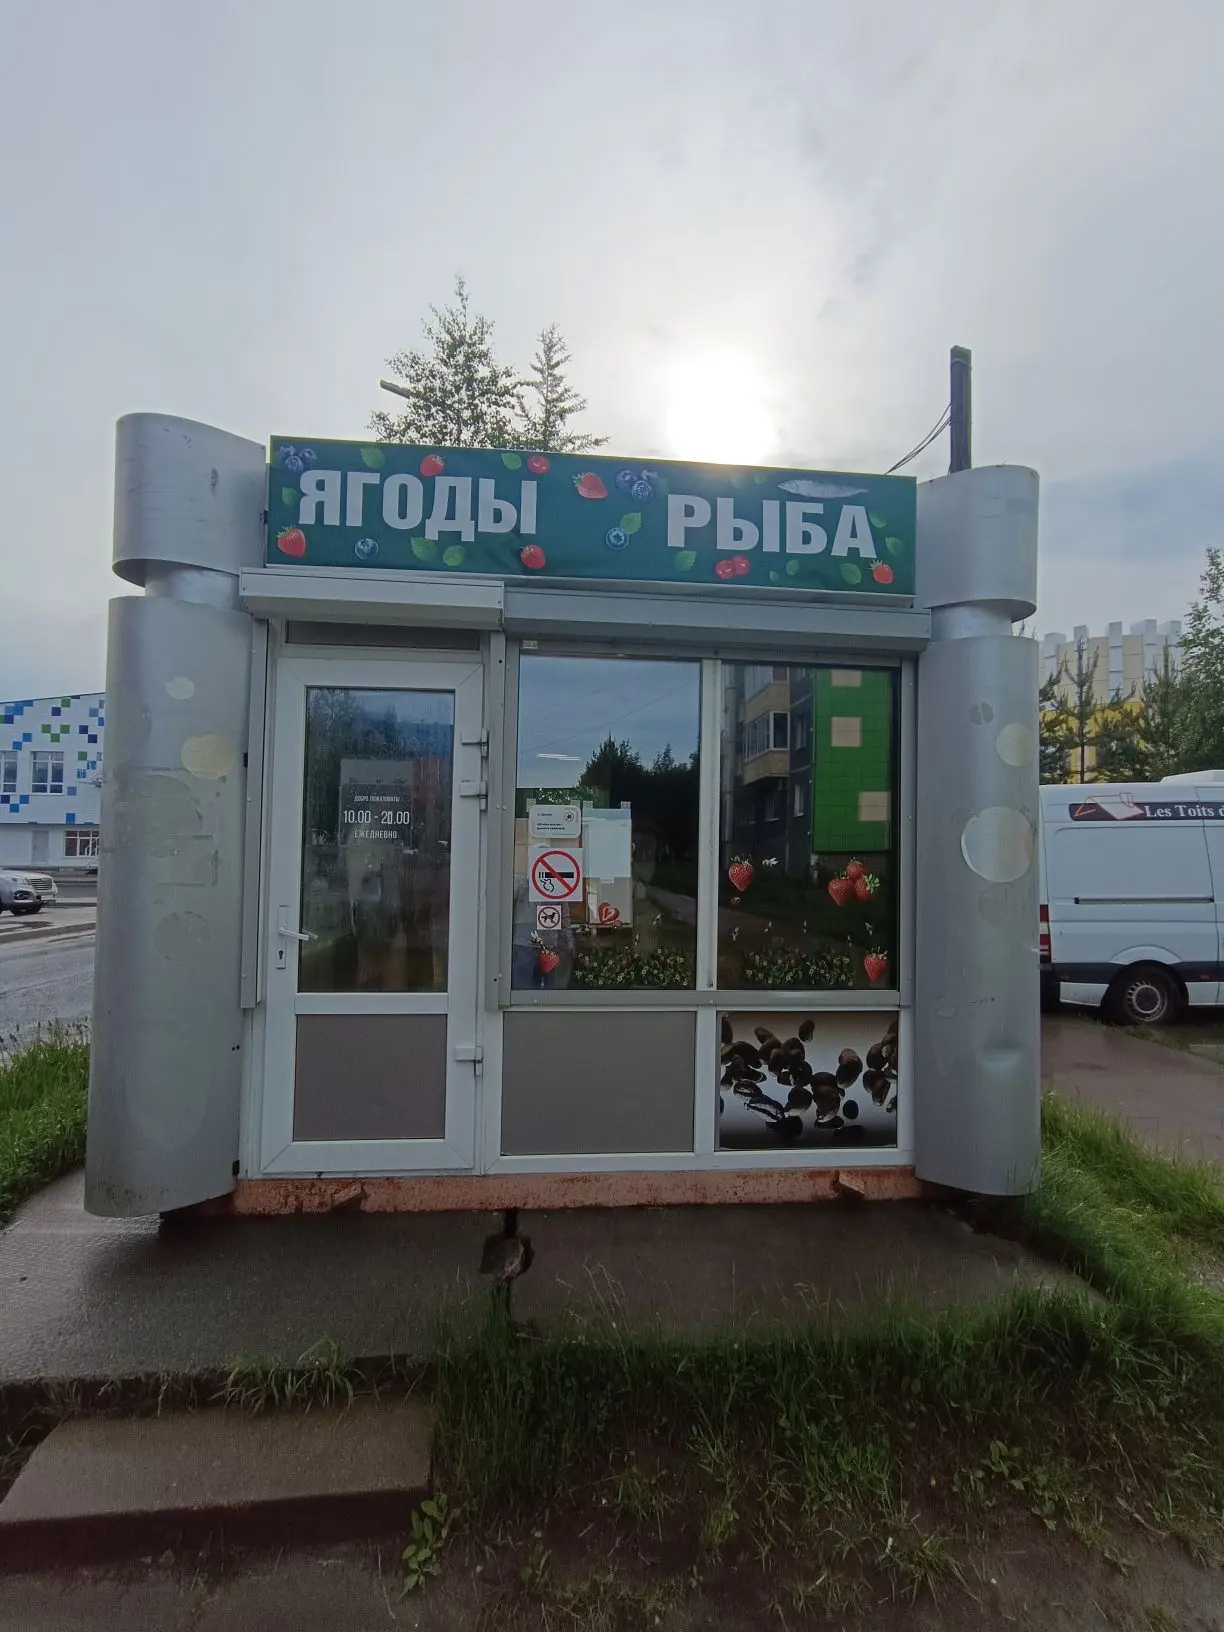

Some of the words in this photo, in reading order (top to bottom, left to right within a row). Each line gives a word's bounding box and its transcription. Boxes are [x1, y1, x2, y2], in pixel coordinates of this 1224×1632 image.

[298, 469, 538, 542] ЯГОДЫ
[667, 493, 877, 559] РЫБА
[343, 810, 371, 823] 10.00
[1143, 805, 1172, 817] Les
[1174, 804, 1215, 817] Toits
[354, 830, 397, 839] ЕЖЕДНЕВНО
